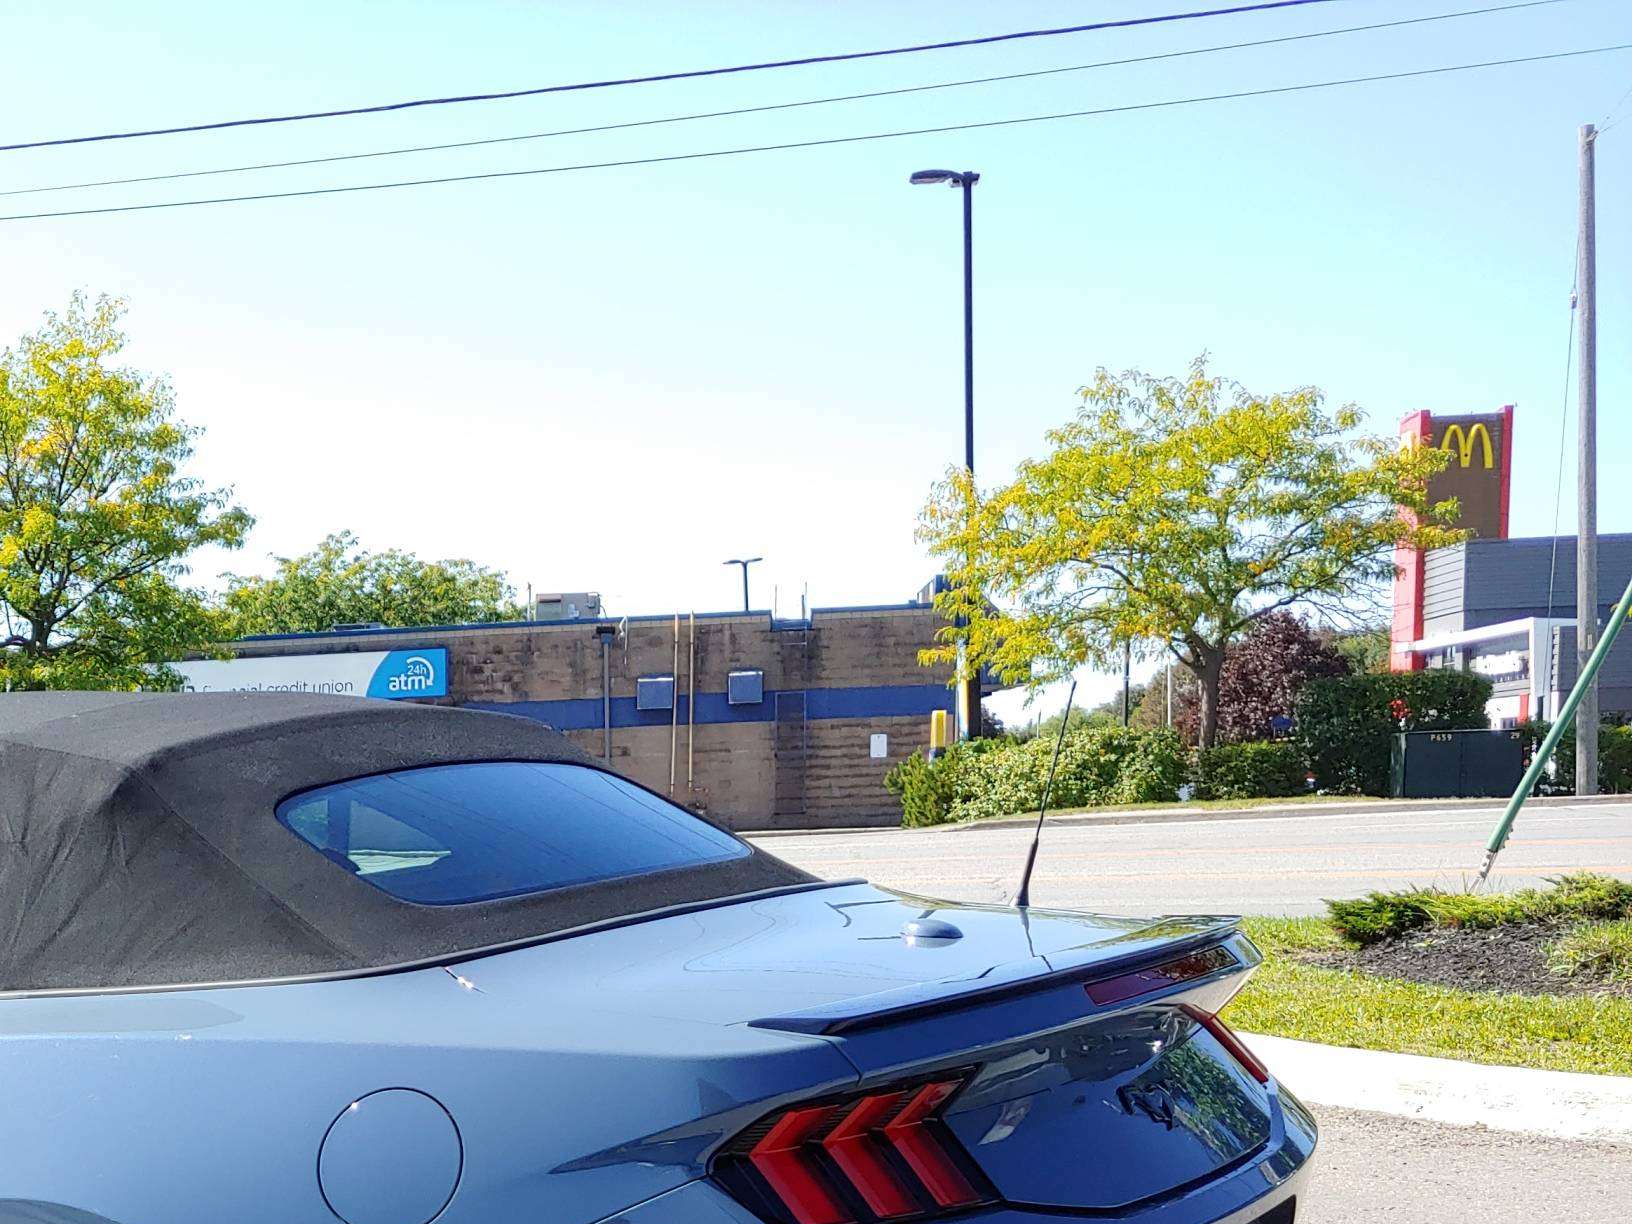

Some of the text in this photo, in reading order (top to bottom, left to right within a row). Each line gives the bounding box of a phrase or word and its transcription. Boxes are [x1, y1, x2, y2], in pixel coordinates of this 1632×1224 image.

[407, 663, 427, 675] 24h
[312, 679, 353, 694] union
[389, 674, 425, 691] atm
